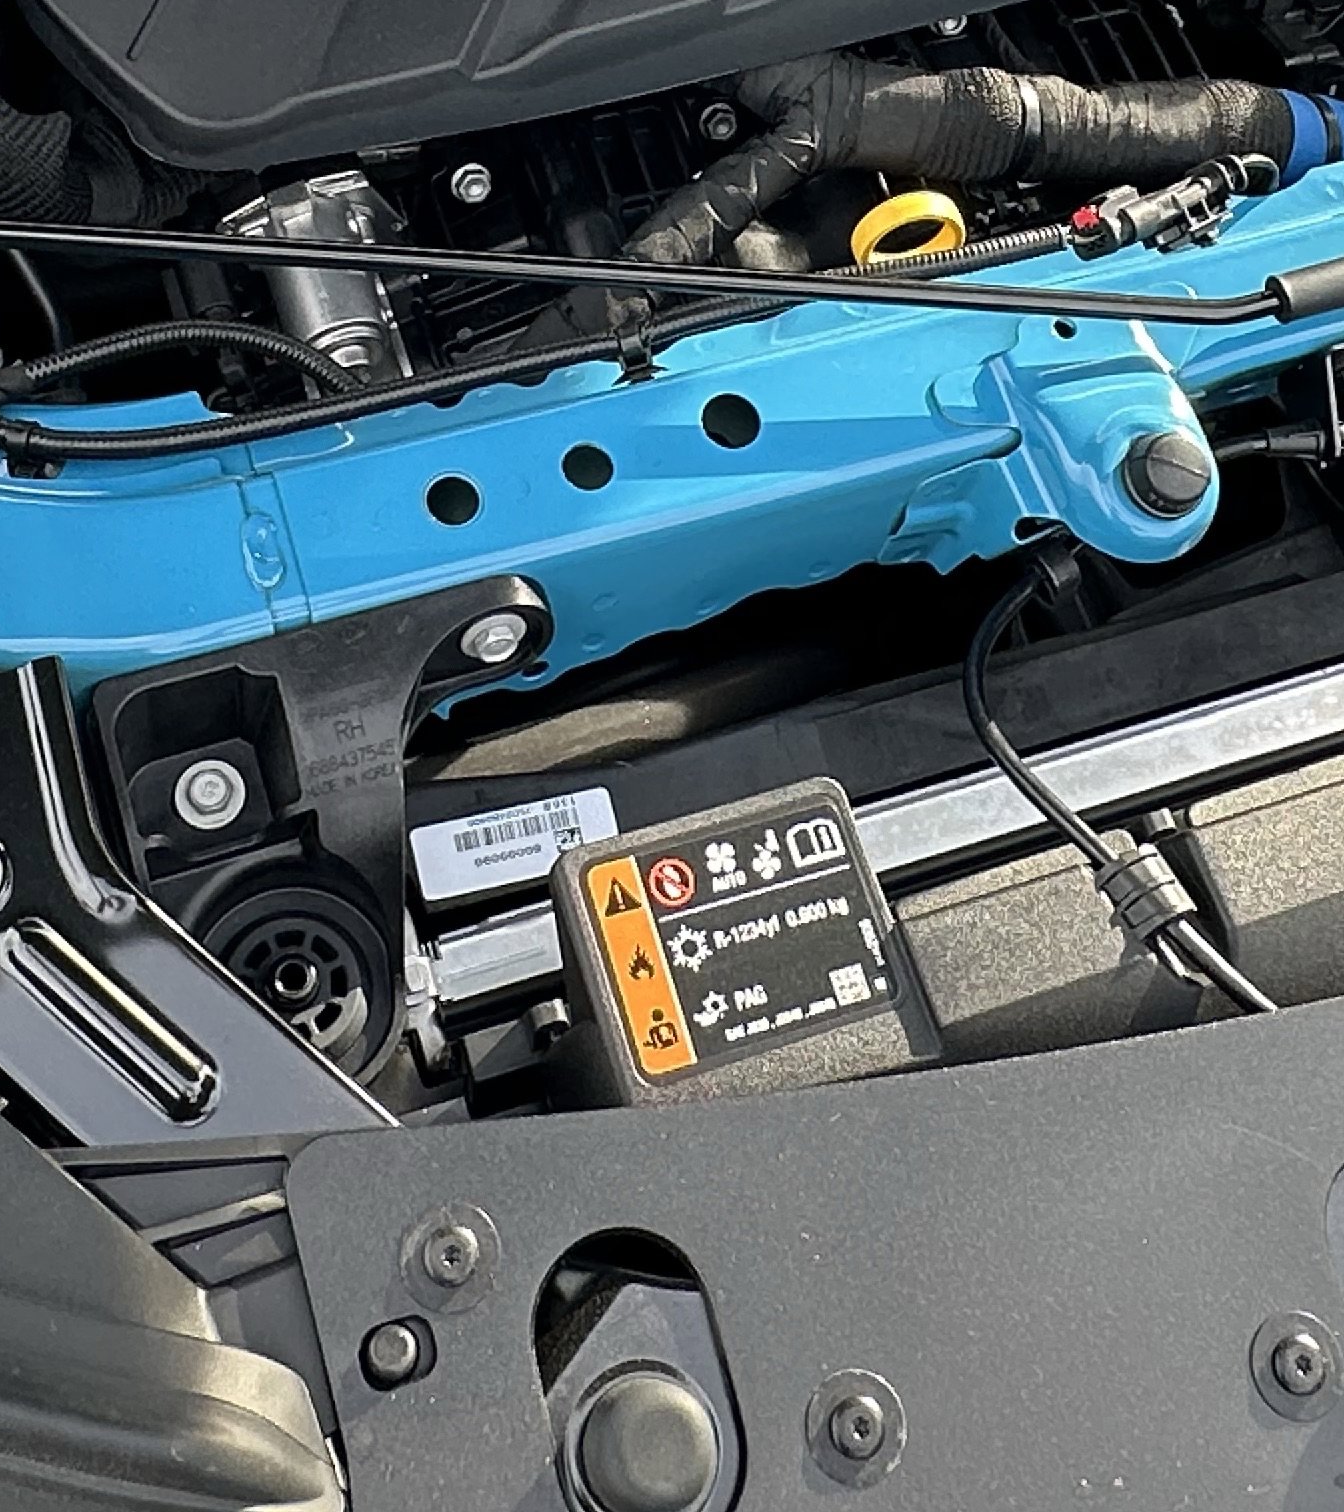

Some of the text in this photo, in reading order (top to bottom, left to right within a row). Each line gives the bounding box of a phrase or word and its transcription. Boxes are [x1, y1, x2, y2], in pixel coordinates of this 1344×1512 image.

[333, 714, 367, 744] RH
[712, 869, 748, 893] AUTO
[712, 914, 781, 950] R-1234yf
[827, 896, 850, 916] kg
[733, 983, 768, 1012] PAG
